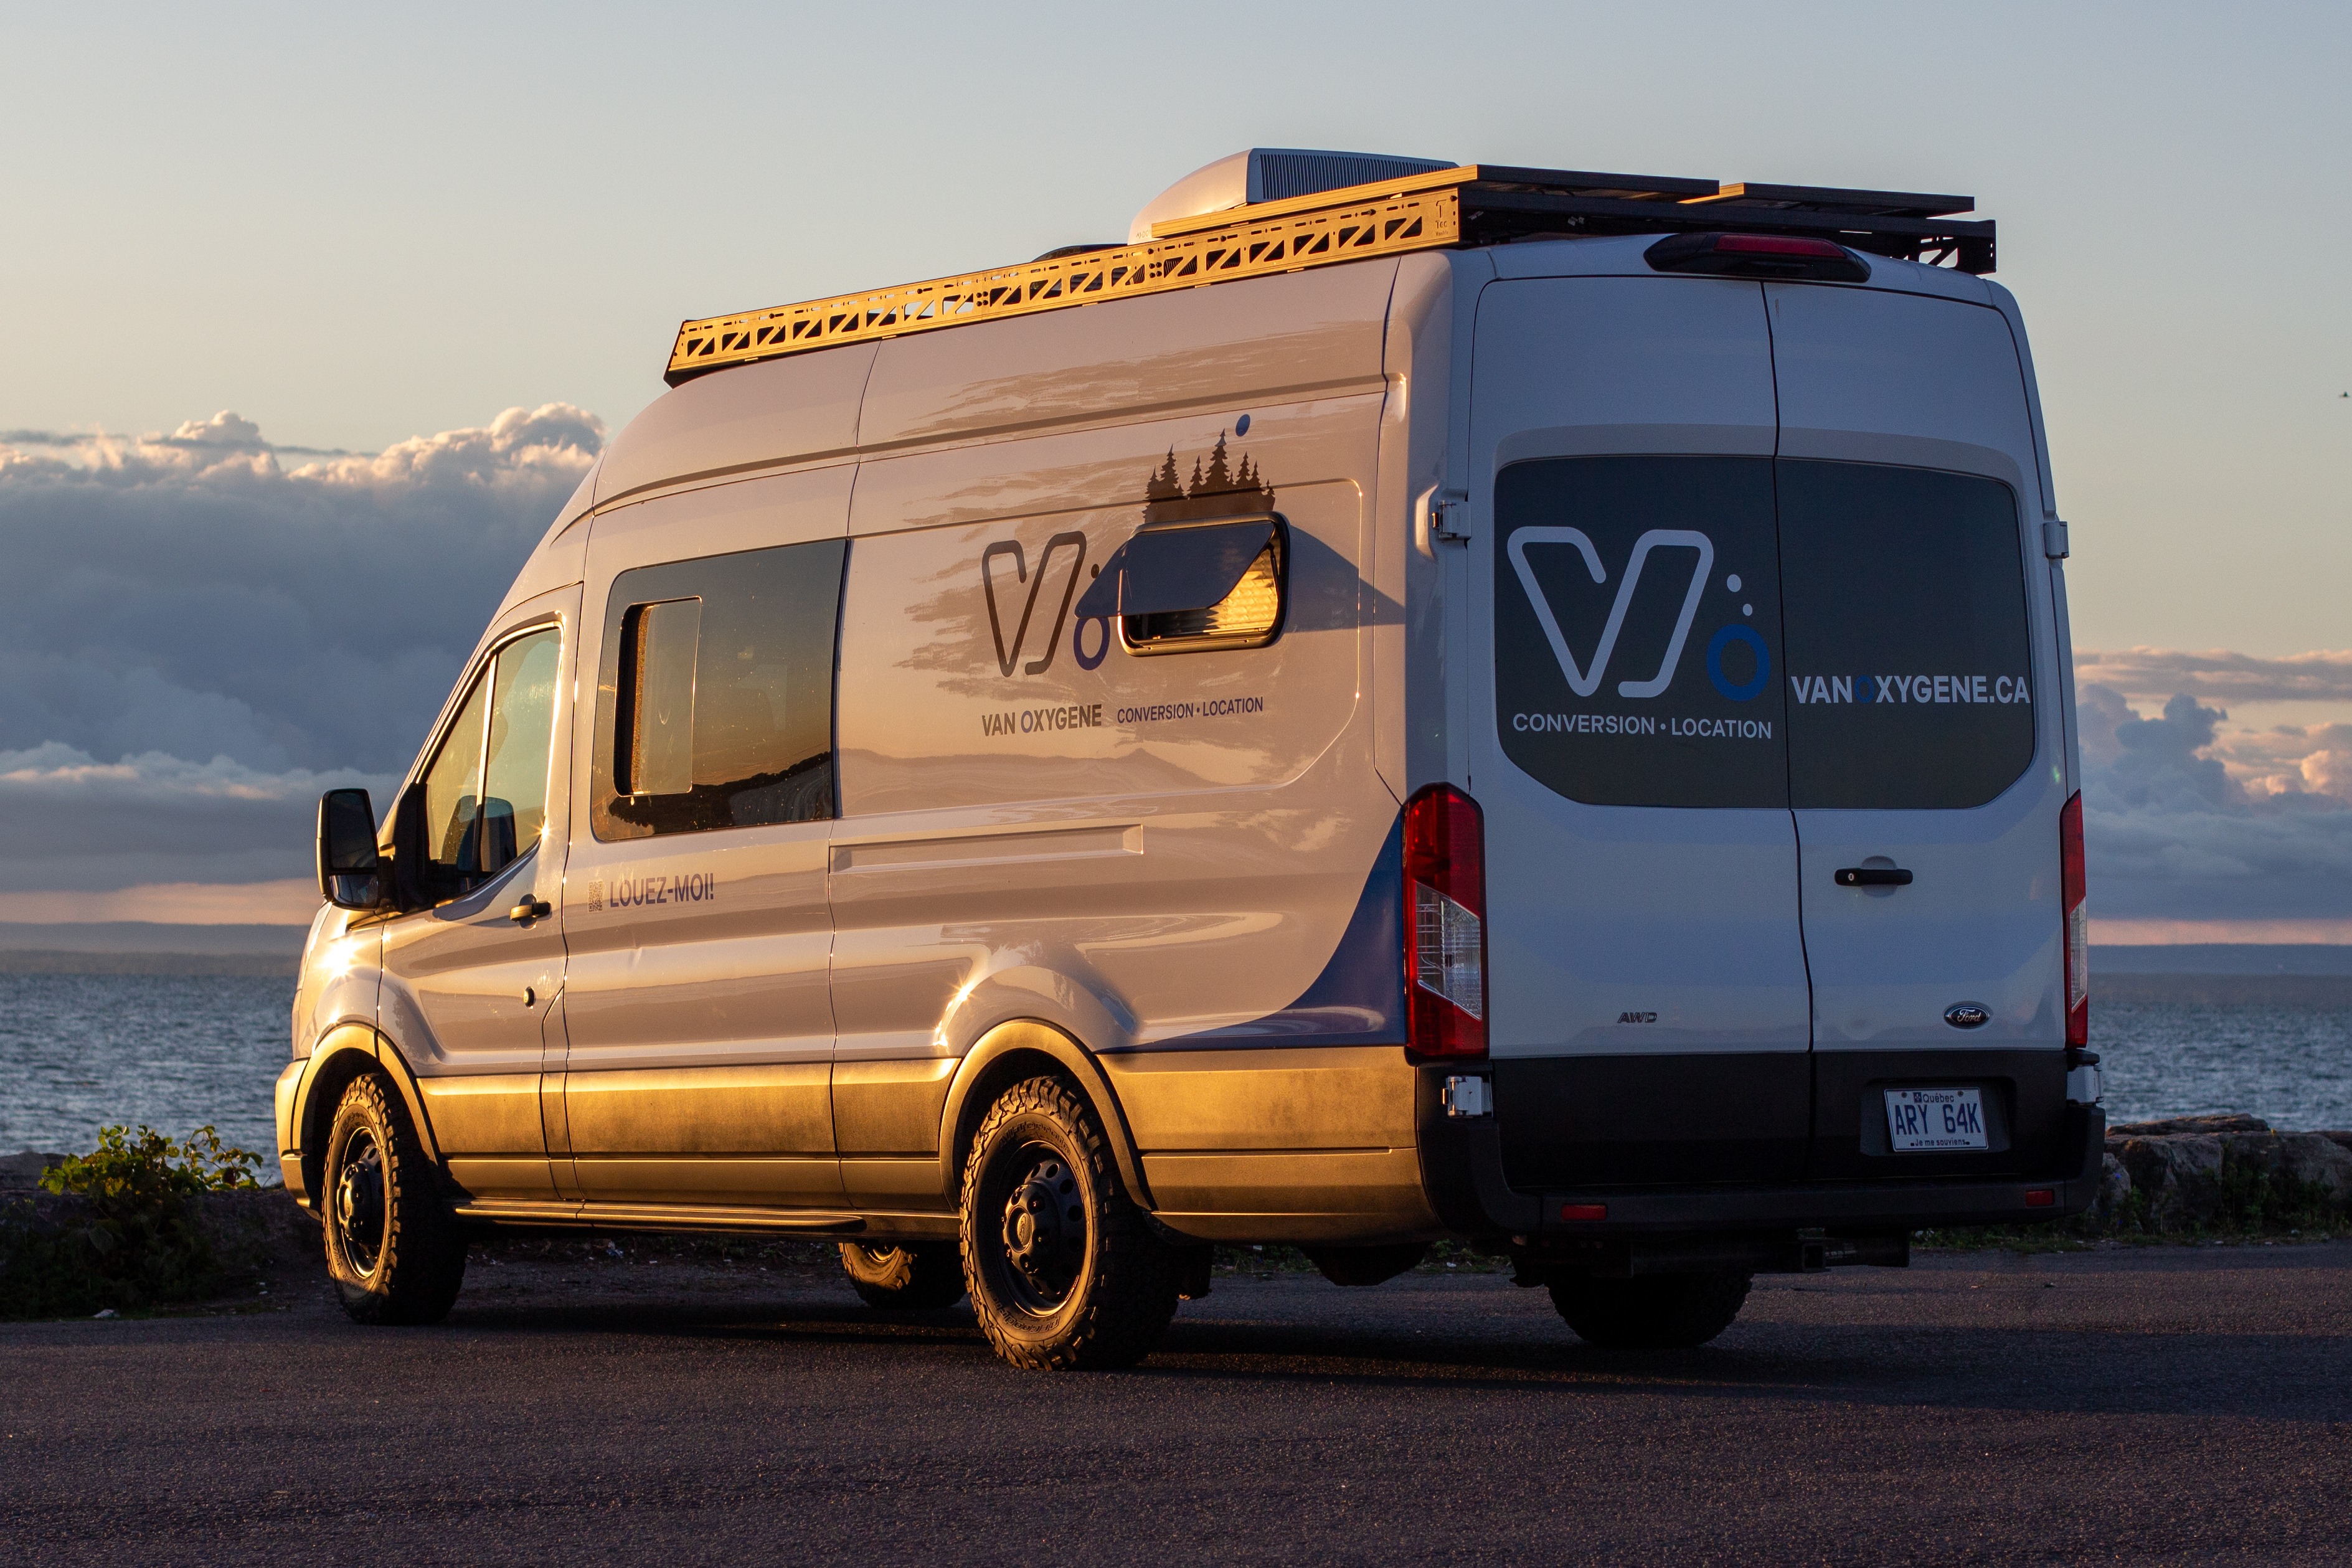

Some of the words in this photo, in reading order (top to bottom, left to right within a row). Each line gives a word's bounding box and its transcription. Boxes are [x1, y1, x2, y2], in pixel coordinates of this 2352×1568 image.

[1791, 675, 2031, 704] VANOXYGENE.CA
[982, 713, 1016, 736] VAN
[1021, 704, 1102, 734] OXYGENE
[1117, 702, 1194, 724] CONVERSION
[1202, 697, 1263, 717] LOCATION
[1513, 713, 1655, 735] CONVERSION
[1671, 717, 1772, 739] LOCATION
[610, 873, 714, 907] LOUEZ-MOI!
[1617, 1012, 1657, 1023] AWD
[1957, 1009, 1981, 1022] Ford
[1922, 1093, 1954, 1103] Québec
[1895, 1105, 1927, 1135] ARY
[1942, 1103, 1981, 1133] 64K
